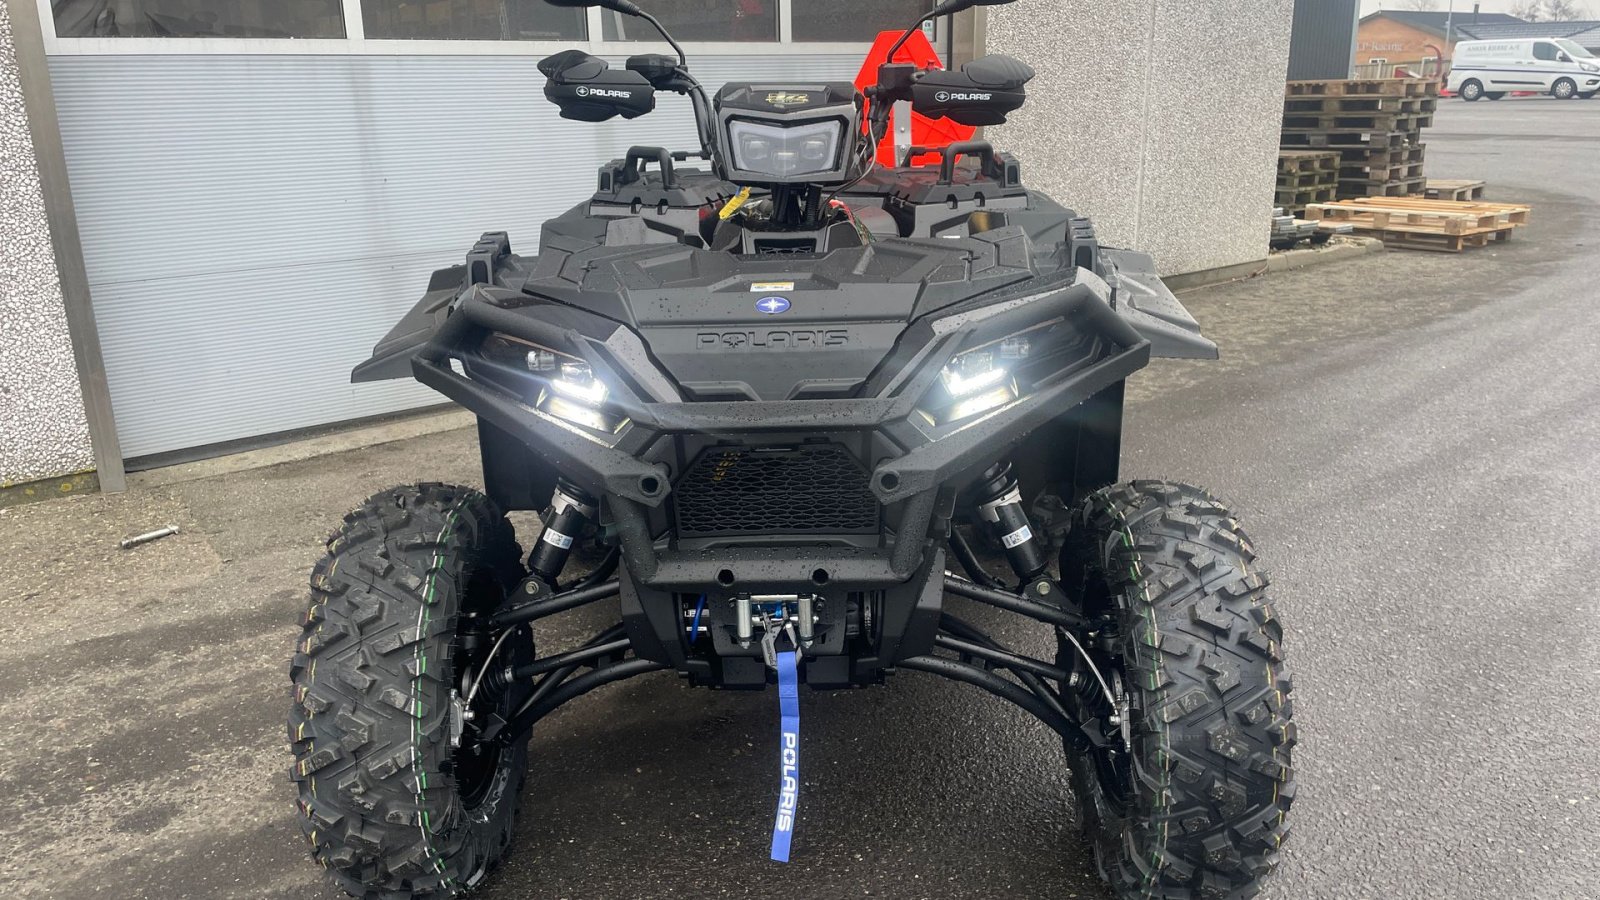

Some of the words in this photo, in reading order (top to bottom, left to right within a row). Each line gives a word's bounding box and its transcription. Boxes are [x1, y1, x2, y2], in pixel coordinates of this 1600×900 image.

[590, 88, 631, 98] POLARIS
[950, 93, 992, 101] POLARIS
[696, 329, 849, 350] POLARIS
[777, 732, 796, 832] POLARIS
